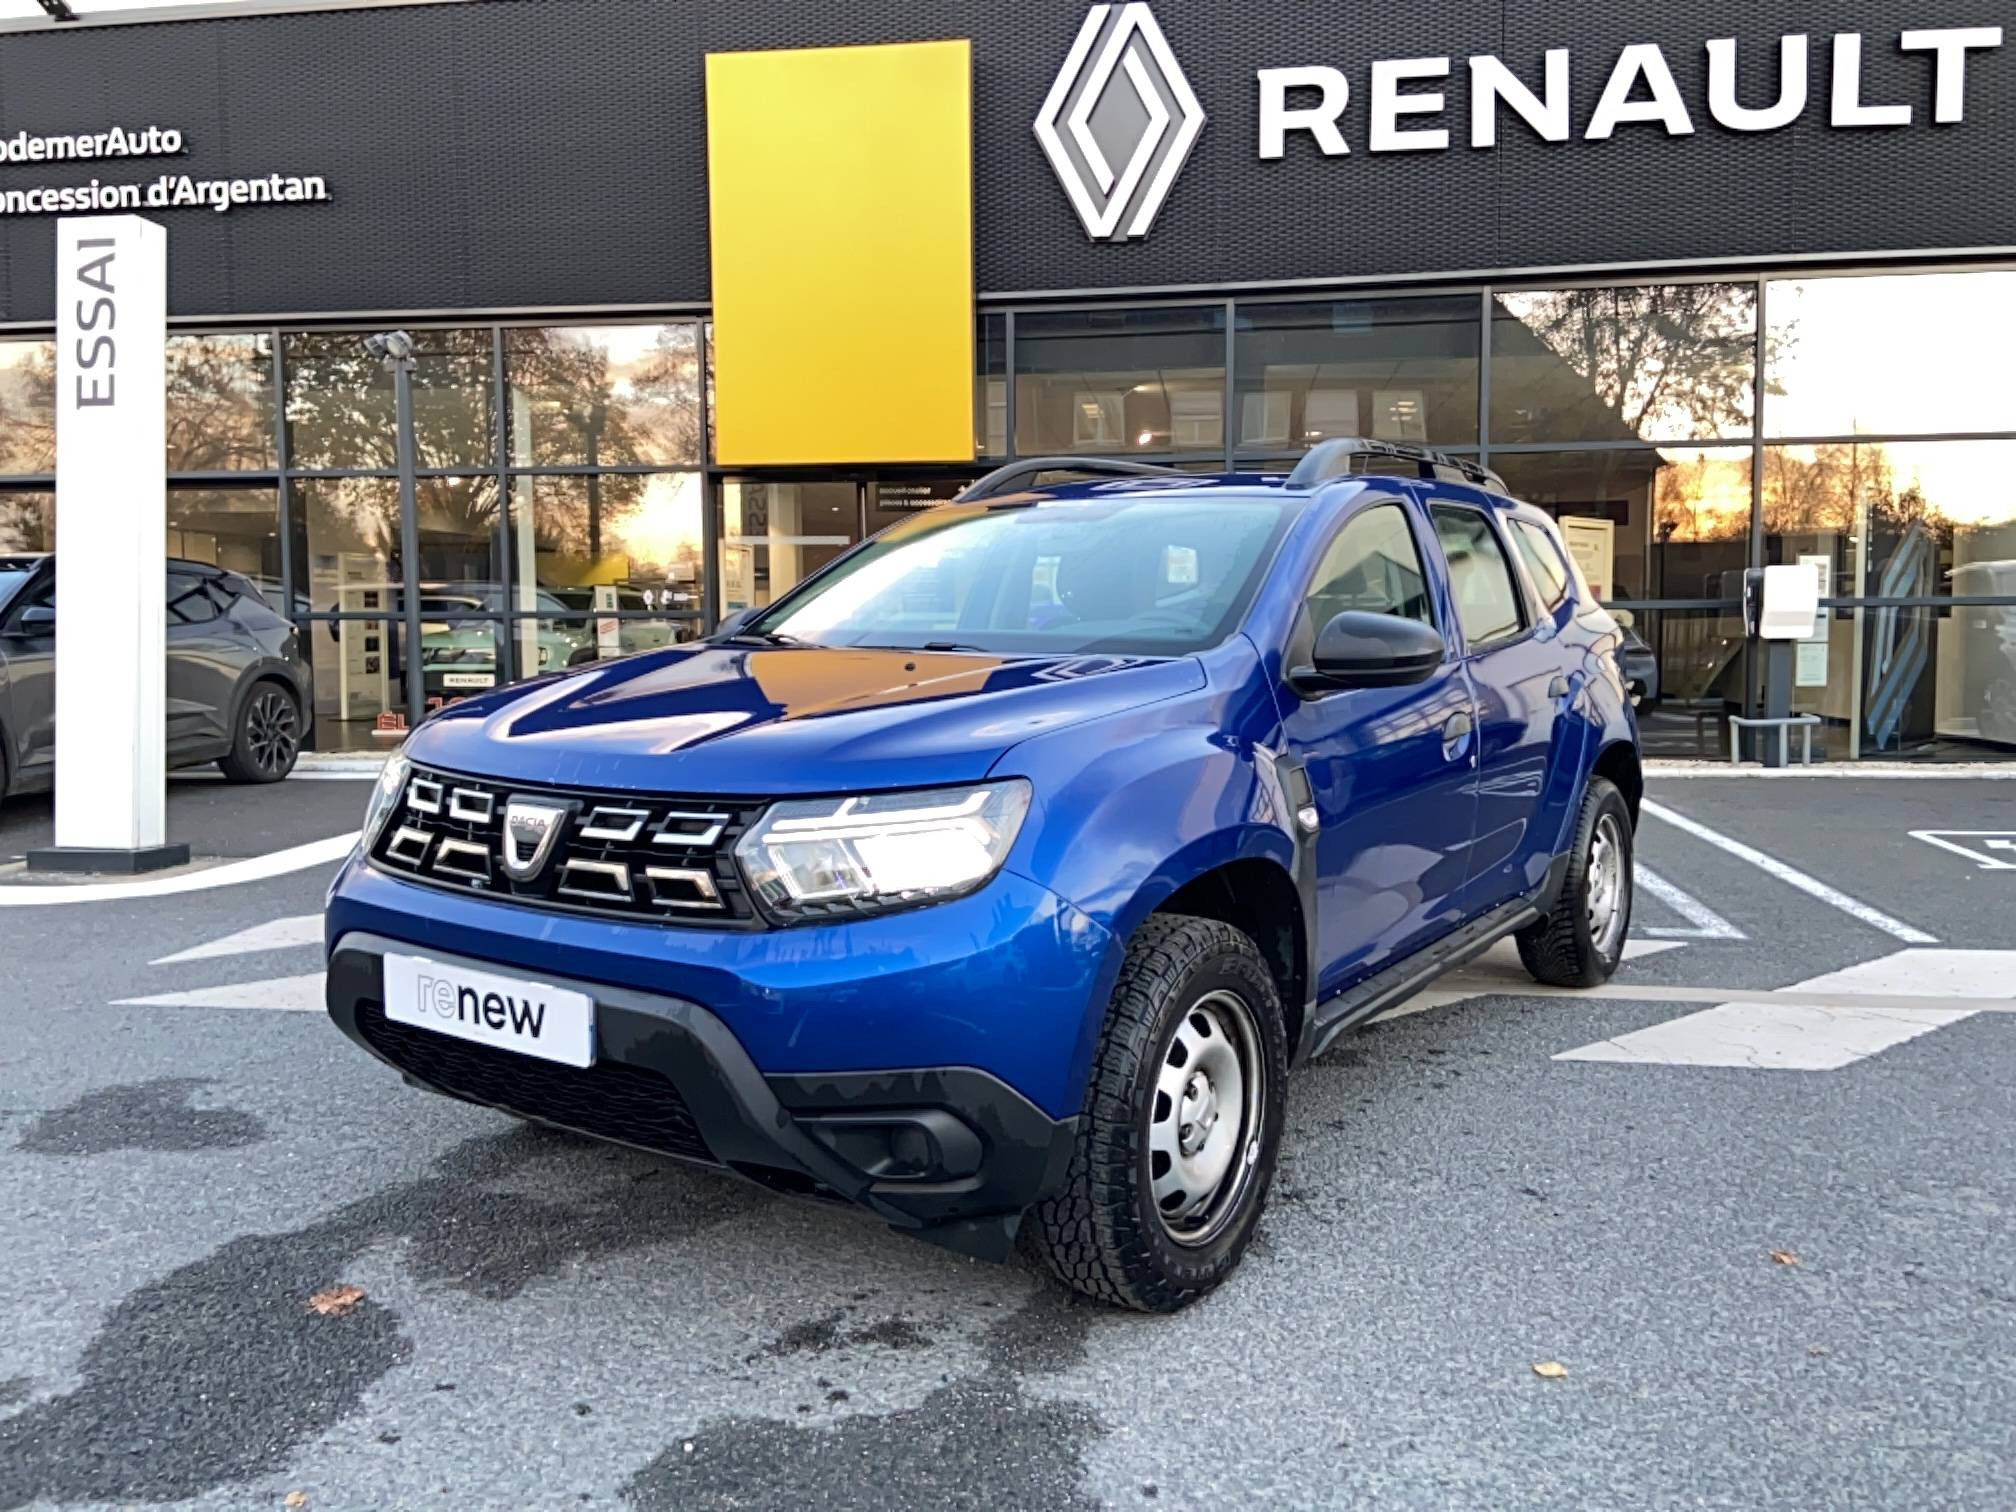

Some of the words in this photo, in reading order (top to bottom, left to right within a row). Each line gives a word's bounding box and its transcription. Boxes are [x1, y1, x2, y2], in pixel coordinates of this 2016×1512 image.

[1256, 26, 2004, 160] RENAULT
[147, 174, 327, 212] d'Argentan
[76, 238, 116, 410] ESSAI
[510, 816, 545, 827] DACIA
[417, 973, 546, 1039] renew
